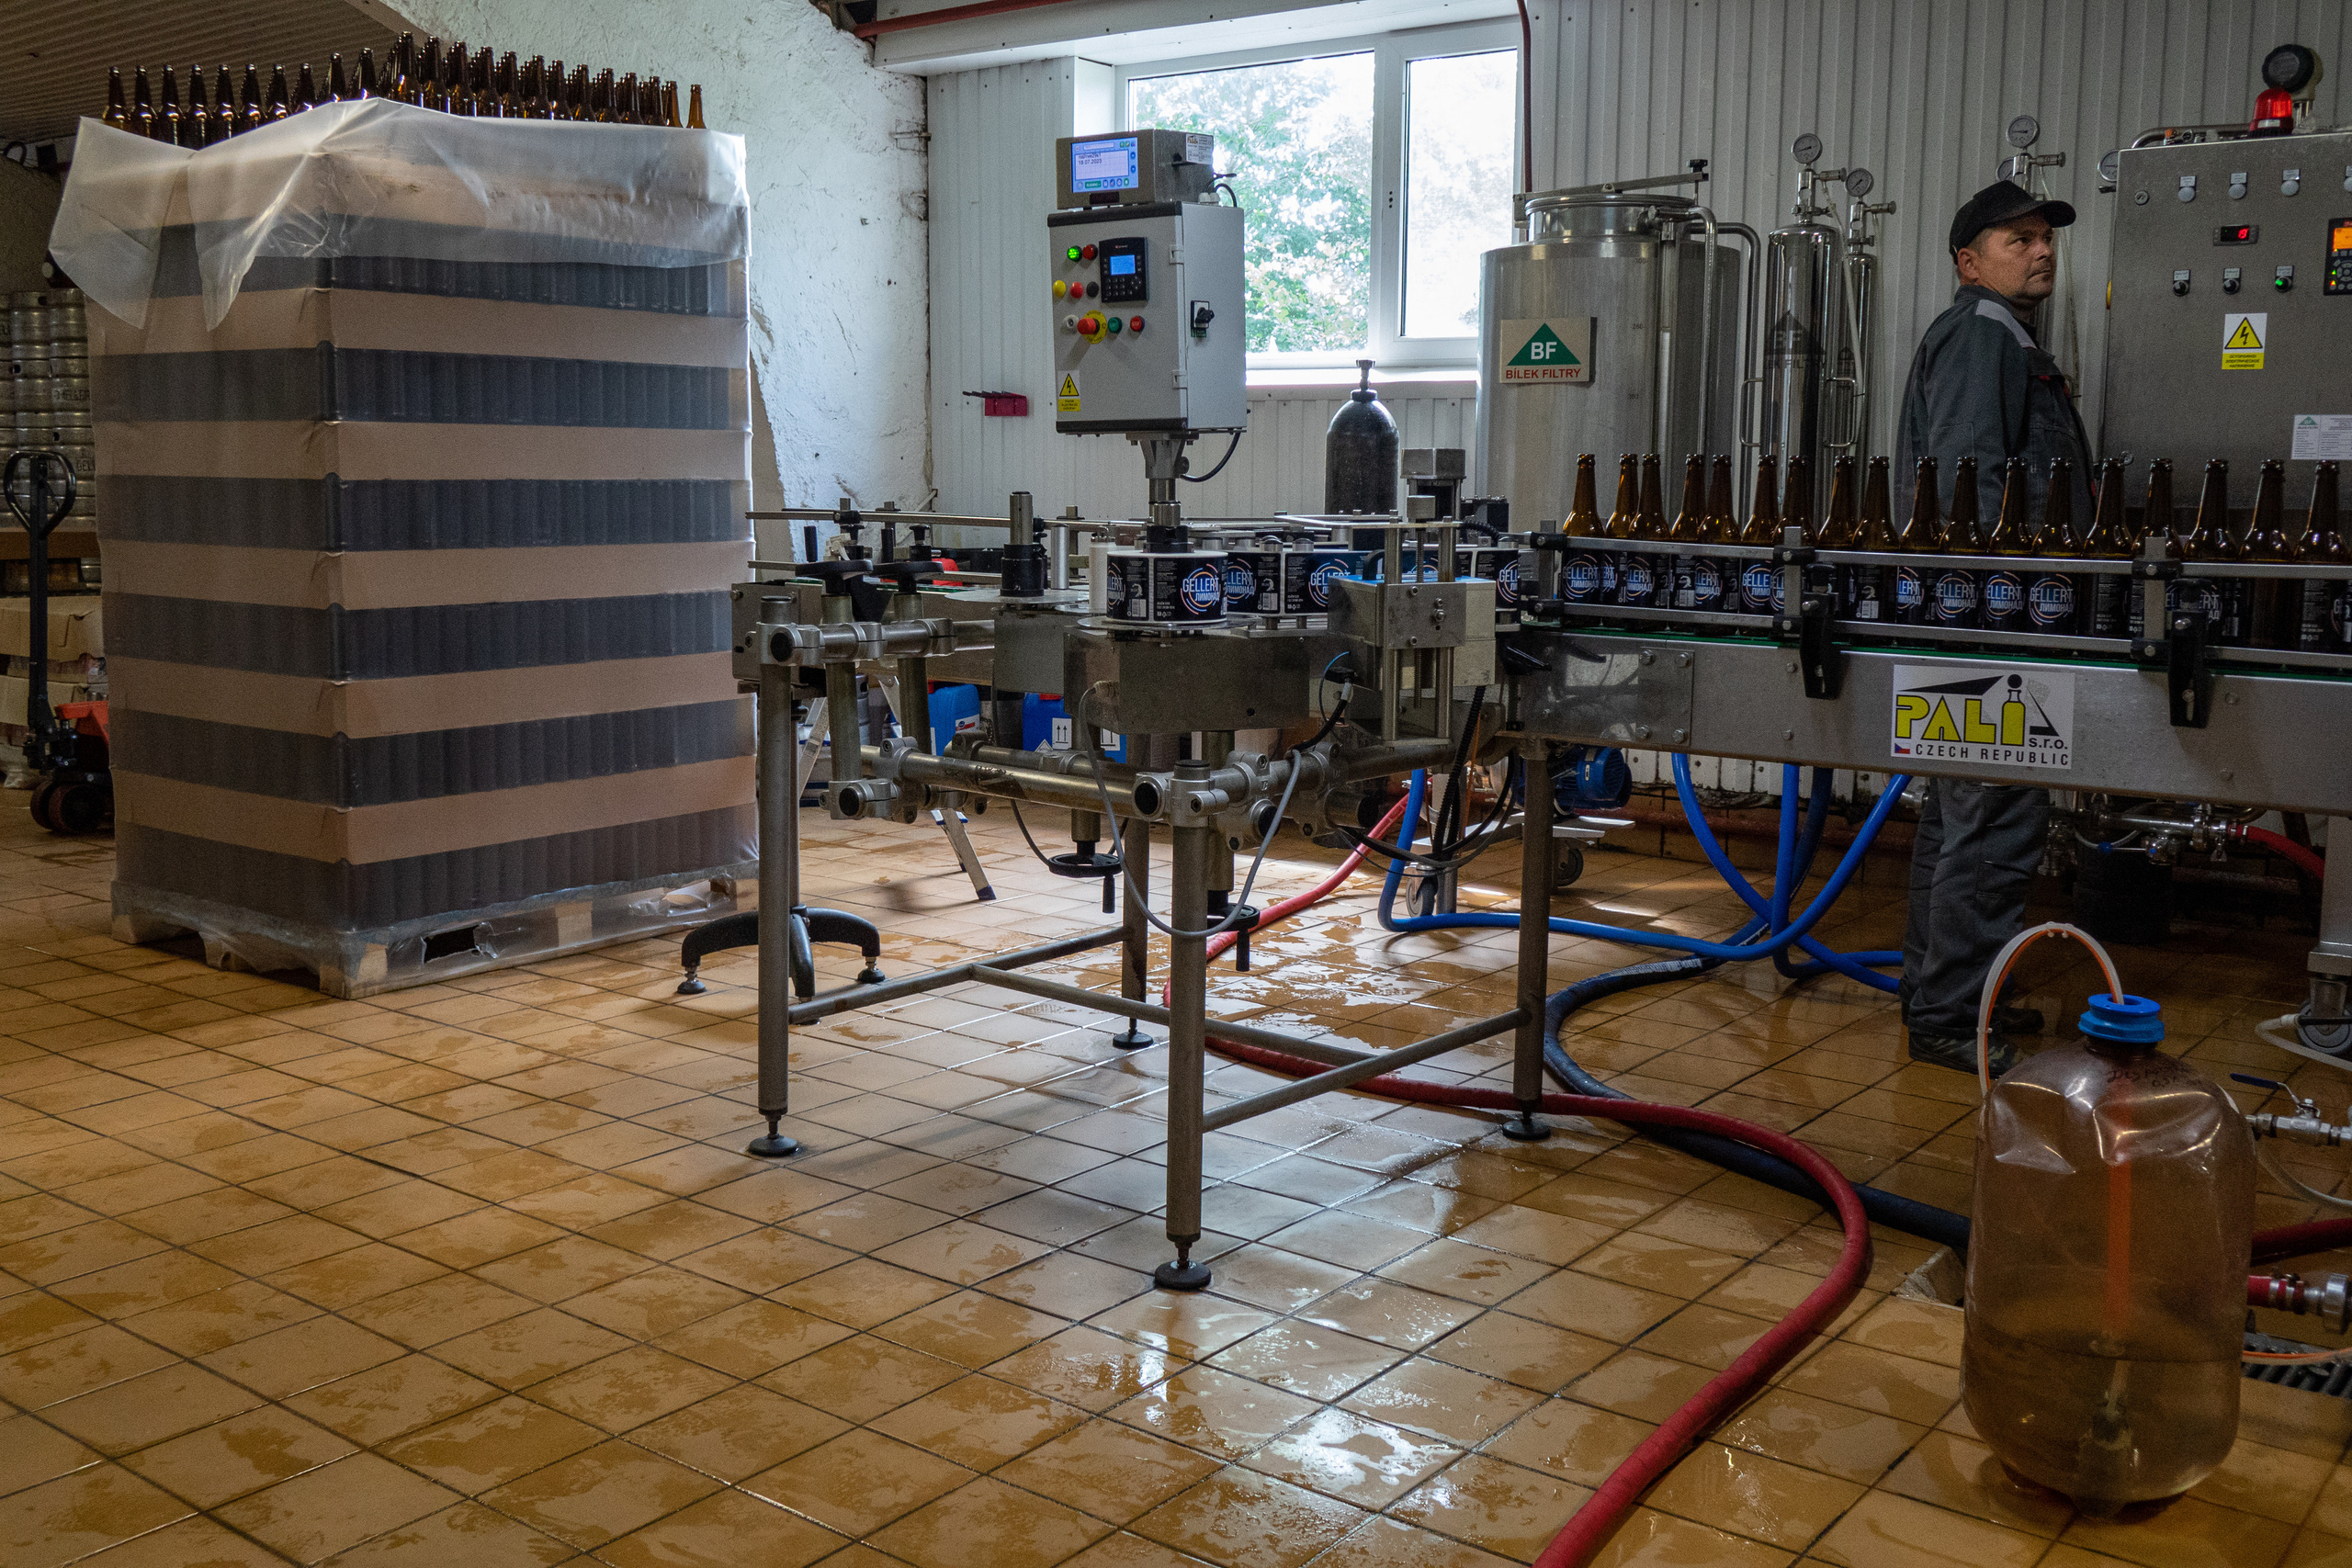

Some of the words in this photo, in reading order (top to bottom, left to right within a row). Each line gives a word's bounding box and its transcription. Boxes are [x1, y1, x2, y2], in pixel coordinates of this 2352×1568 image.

[1531, 342, 1557, 360] BF
[1506, 368, 1539, 378] BÍLEK
[1543, 368, 1581, 378] FILTRY
[1227, 571, 1253, 585] LLERT
[1563, 566, 1599, 580] GELLERT
[1742, 573, 1770, 587] GELLE
[1182, 577, 1219, 592] GELLERT
[1195, 591, 1220, 603] ЛИМОНАД
[1987, 584, 2023, 600] ELLERT
[2030, 587, 2074, 603] GELLERT
[2040, 603, 2074, 613] ЛИМОНАД
[2029, 738, 2067, 750] s.r.o.
[1916, 744, 1969, 759] CZECH
[1980, 749, 2069, 766] REPUBLIC
